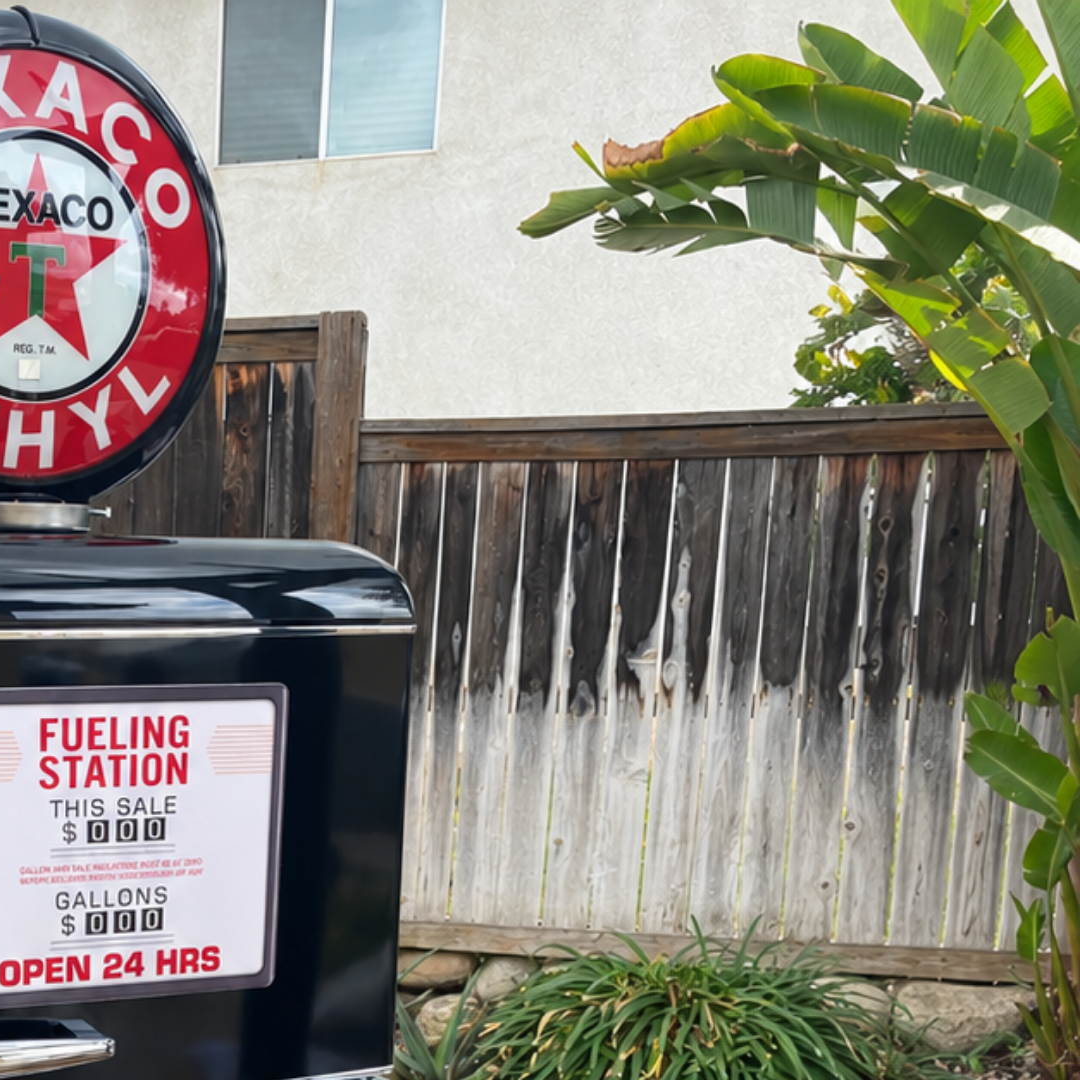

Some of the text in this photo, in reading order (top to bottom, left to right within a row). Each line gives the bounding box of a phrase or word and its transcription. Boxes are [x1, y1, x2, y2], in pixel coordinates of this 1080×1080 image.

[9, 242, 66, 319] T
[39, 715, 190, 752] FUELING
[38, 752, 189, 790] STATION
[49, 795, 177, 818] THIS SALE
[55, 886, 168, 911] GALLONS
[102, 951, 144, 980] 24
[155, 946, 221, 976] HRS
